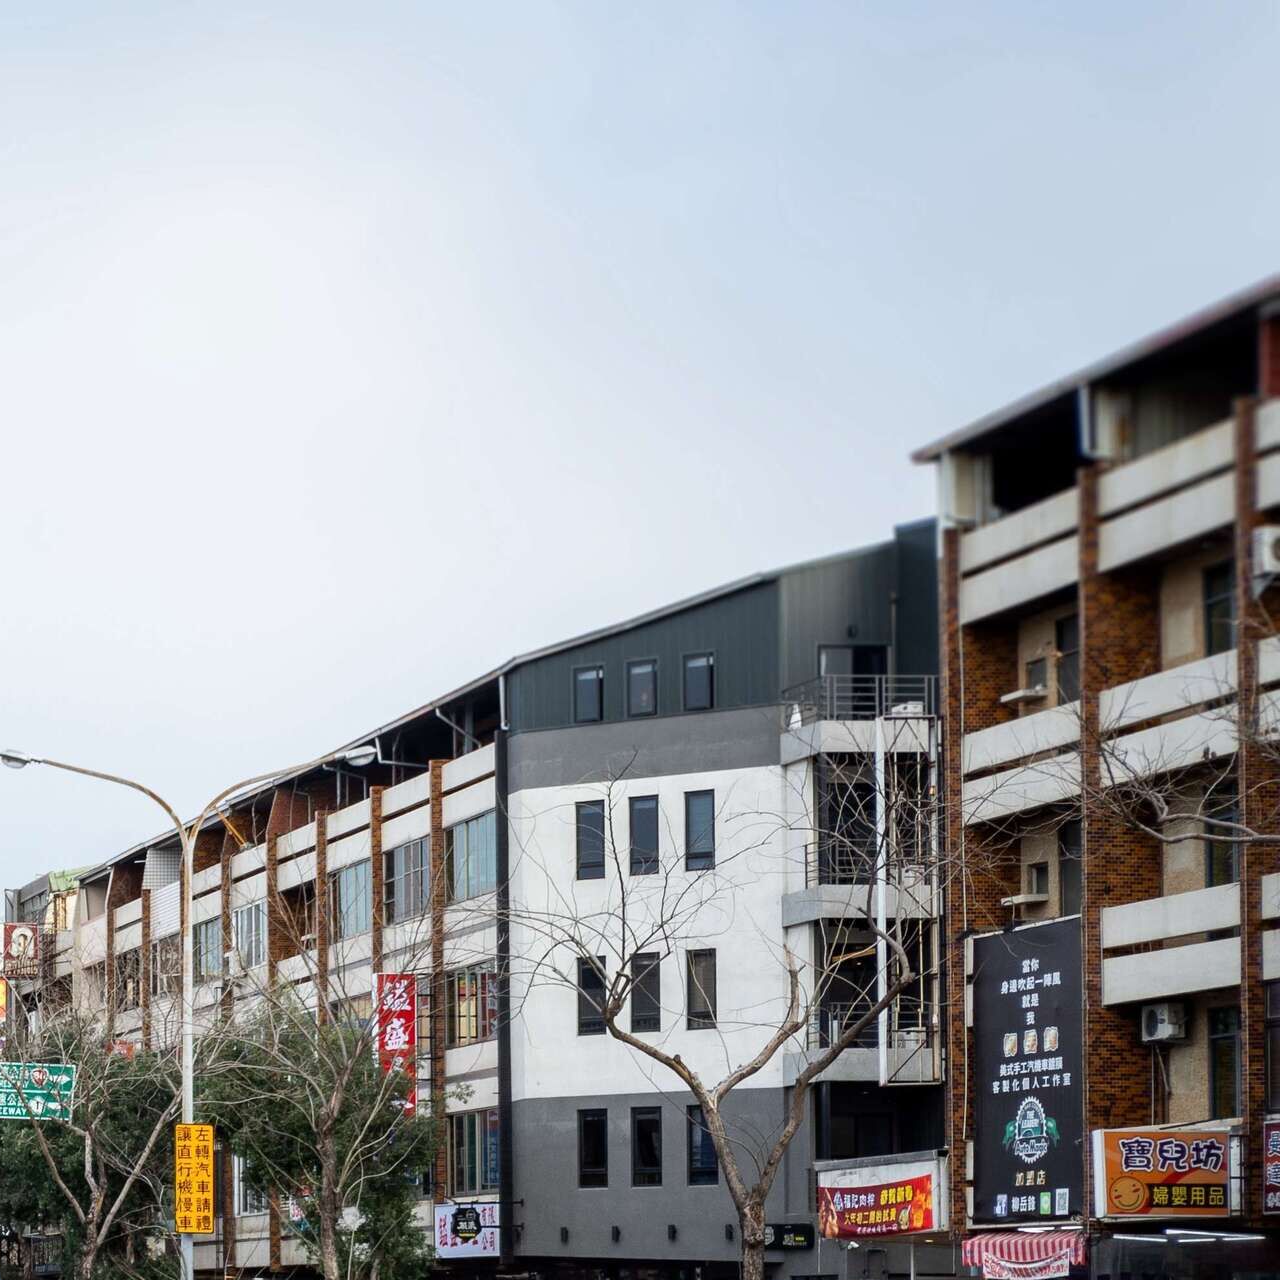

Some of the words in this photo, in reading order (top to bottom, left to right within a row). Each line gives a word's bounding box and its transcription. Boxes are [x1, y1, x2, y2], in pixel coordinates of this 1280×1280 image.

[1022, 958, 1040, 974] 當你
[1001, 972, 1061, 995] 身邊吹起一陣風
[1022, 993, 1040, 1009] 就是
[1026, 1011, 1035, 1025] 我
[1119, 1137, 1225, 1173] 寶兒坊
[177, 1126, 193, 1230] 讓直行機慢車
[1015, 1169, 1046, 1187] 加盟店
[1152, 1186, 1225, 1206] 婦嬰用品
